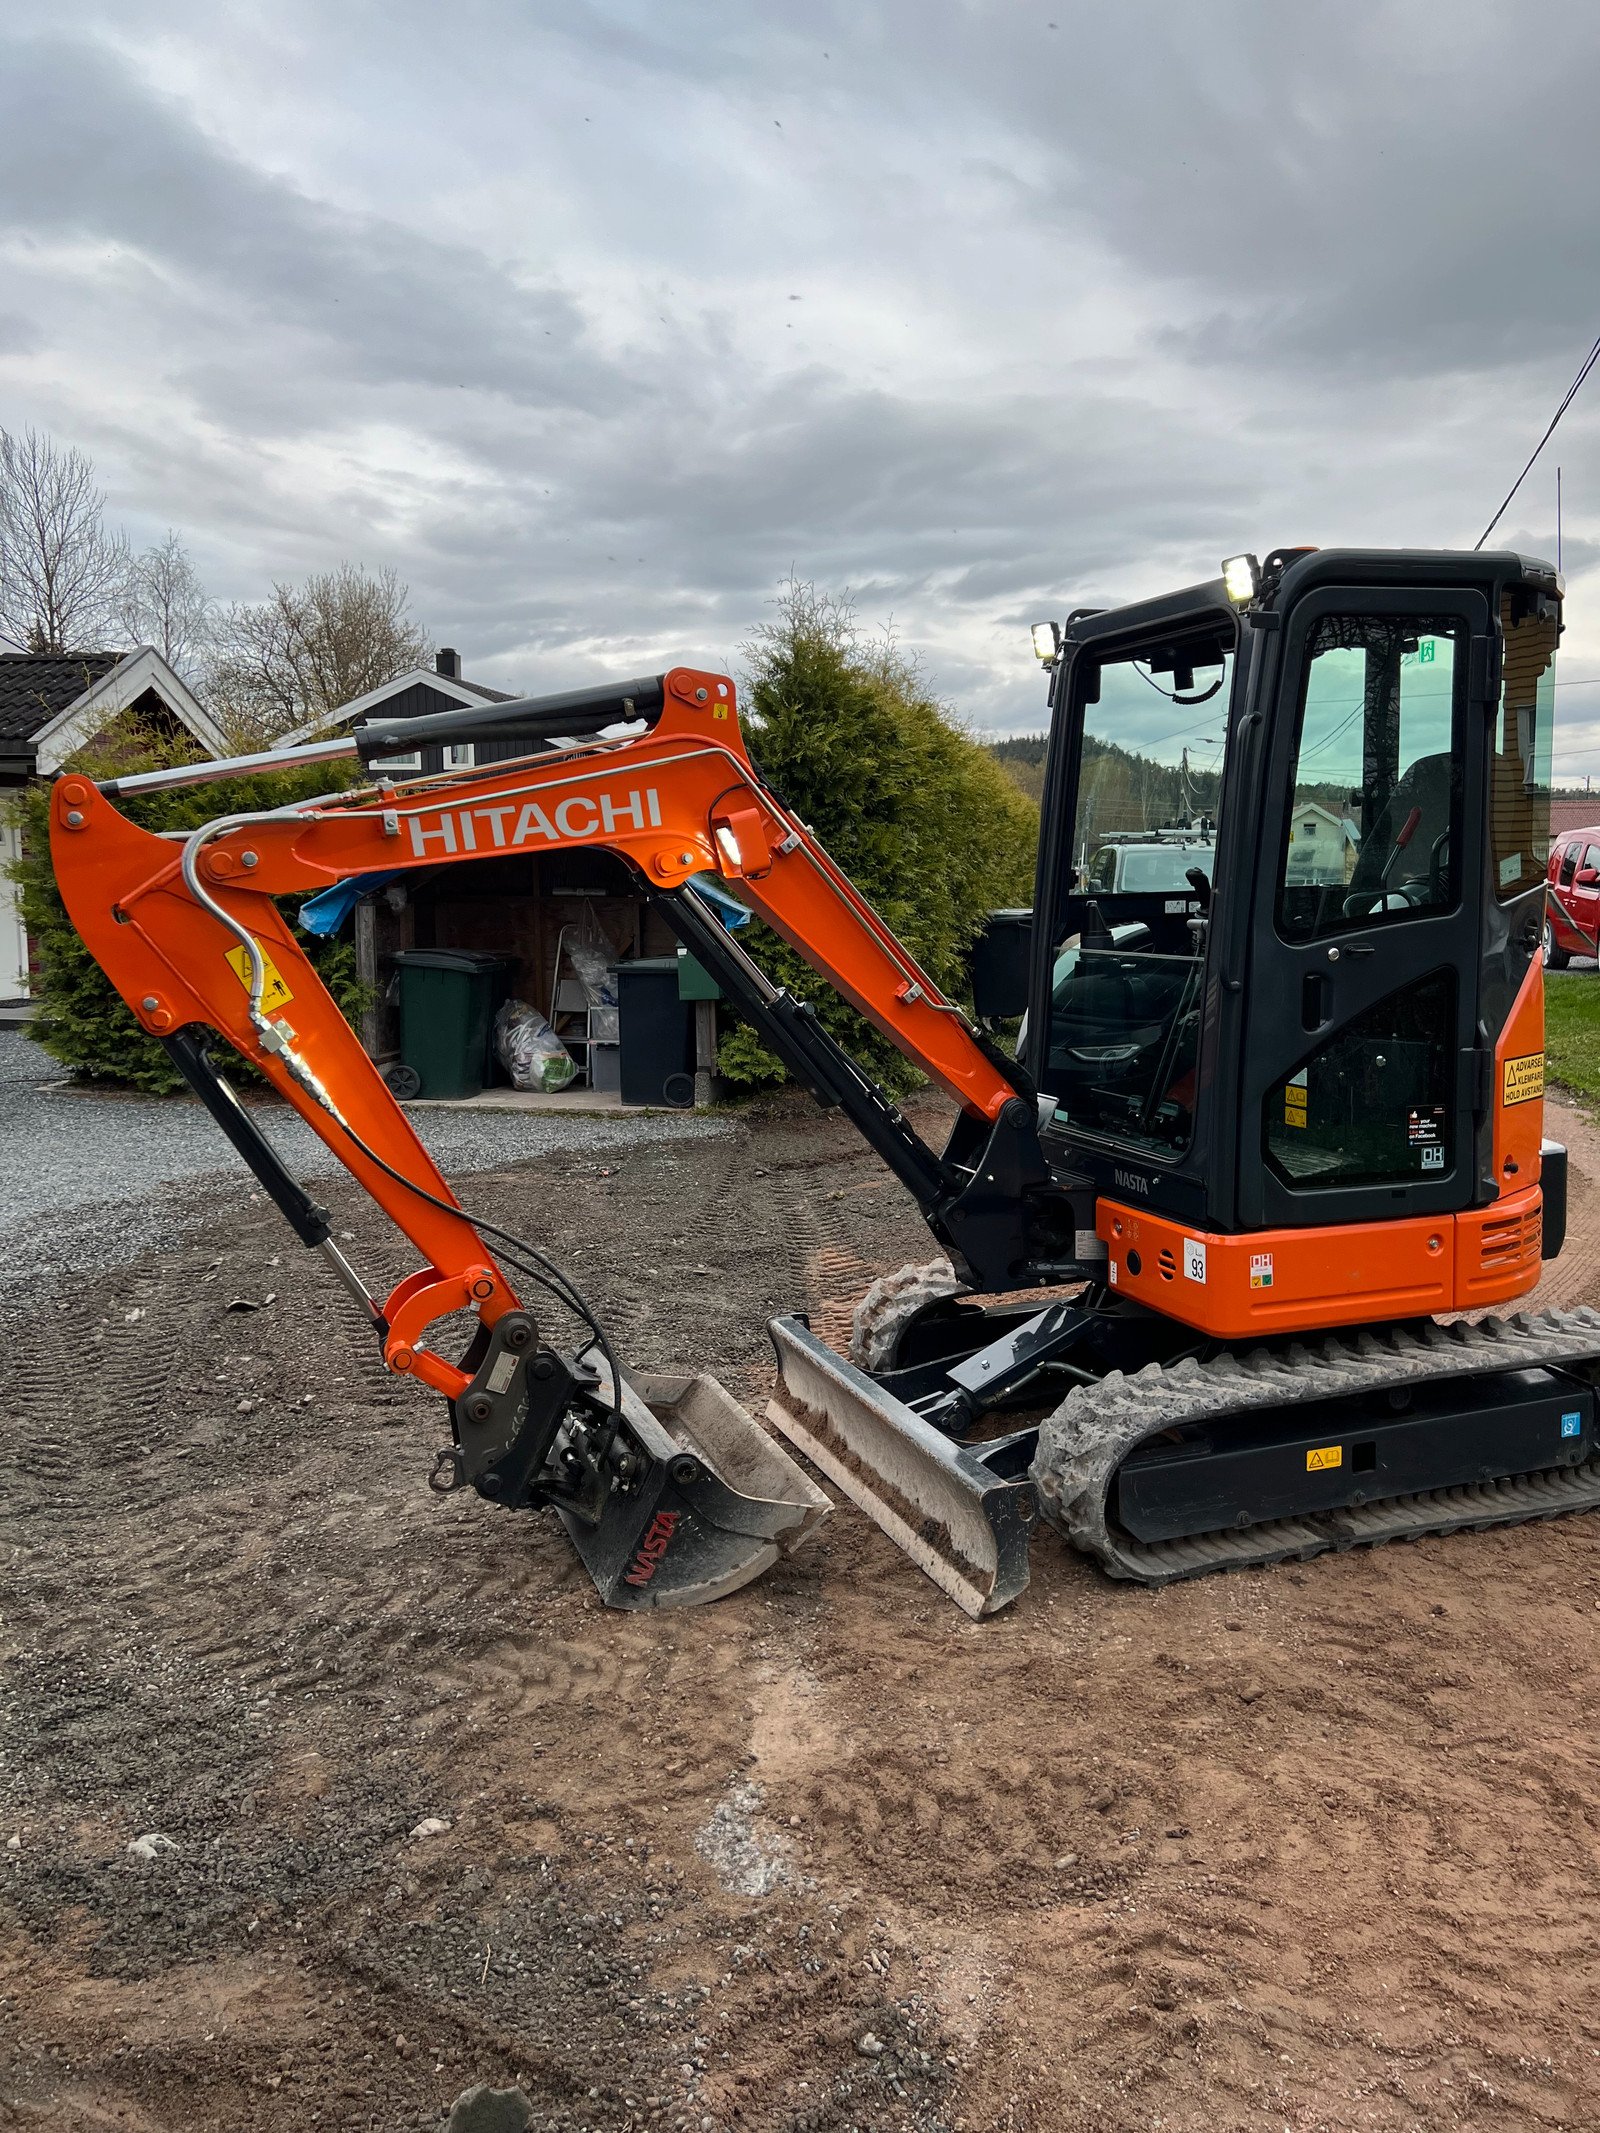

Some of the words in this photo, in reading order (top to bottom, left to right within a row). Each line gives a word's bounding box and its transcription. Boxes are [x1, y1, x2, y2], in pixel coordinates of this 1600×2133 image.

[408, 788, 662, 857] HITACHI
[1515, 1057, 1543, 1072] ADVARSEL
[1517, 1071, 1543, 1085] KLEMFARE
[1506, 1089, 1520, 1101] HOLD
[1114, 1168, 1148, 1195] NASTA
[1191, 1258, 1204, 1279] 93
[624, 1510, 681, 1587] NASTA
